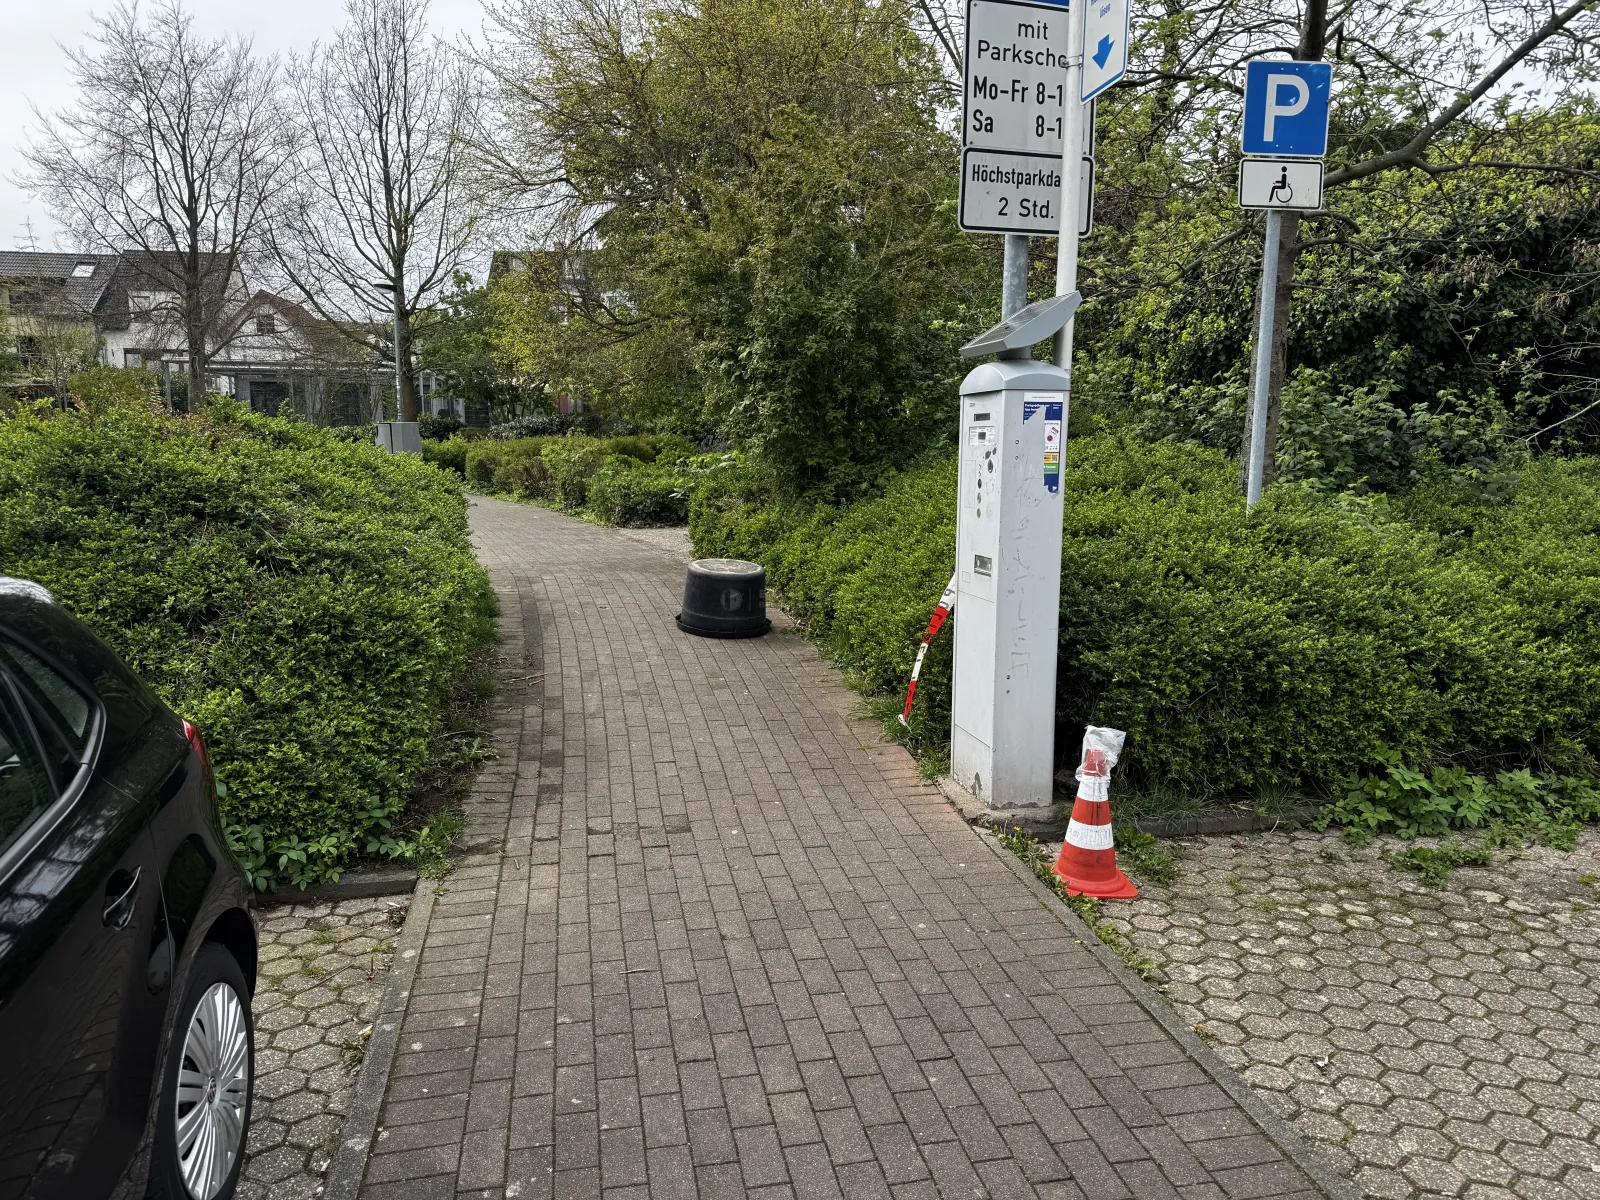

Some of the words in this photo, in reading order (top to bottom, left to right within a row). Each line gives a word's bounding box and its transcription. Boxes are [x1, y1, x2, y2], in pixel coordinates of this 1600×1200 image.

[1017, 20, 1049, 40] mit
[972, 75, 1029, 103] Mo-Fr
[1036, 81, 1063, 107] 8-1
[1262, 73, 1311, 143] P
[972, 108, 994, 134] Sa
[1035, 114, 1062, 140] 8-1
[971, 163, 1061, 190] Höchstparkda
[997, 197, 1009, 217] 2
[1018, 198, 1055, 220] Std.
